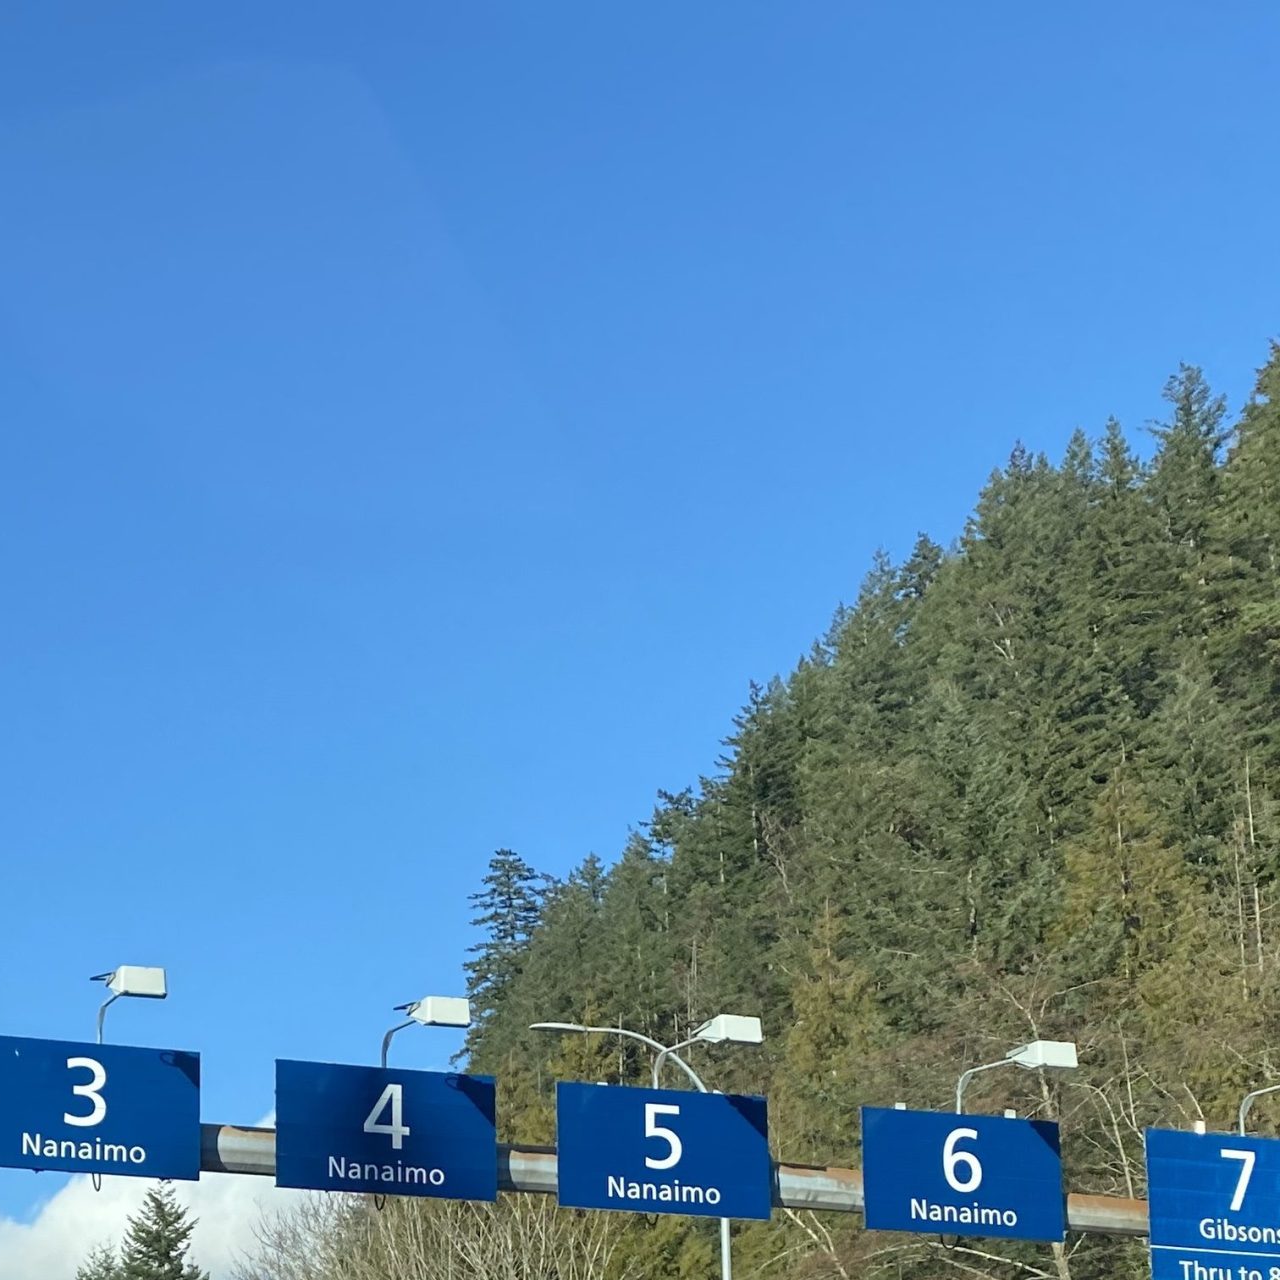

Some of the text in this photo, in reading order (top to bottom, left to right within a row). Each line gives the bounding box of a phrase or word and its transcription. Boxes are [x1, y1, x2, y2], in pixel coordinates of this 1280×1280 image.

[63, 1057, 107, 1127] 3
[363, 1083, 410, 1150] 4
[22, 1132, 146, 1164] Nanaimo
[644, 1103, 683, 1170] 5
[942, 1127, 983, 1193] 6
[328, 1156, 445, 1186] Nanaimo
[607, 1175, 721, 1205] Nanaimo
[1220, 1148, 1256, 1211] 7
[910, 1198, 1018, 1227] Nanaimo
